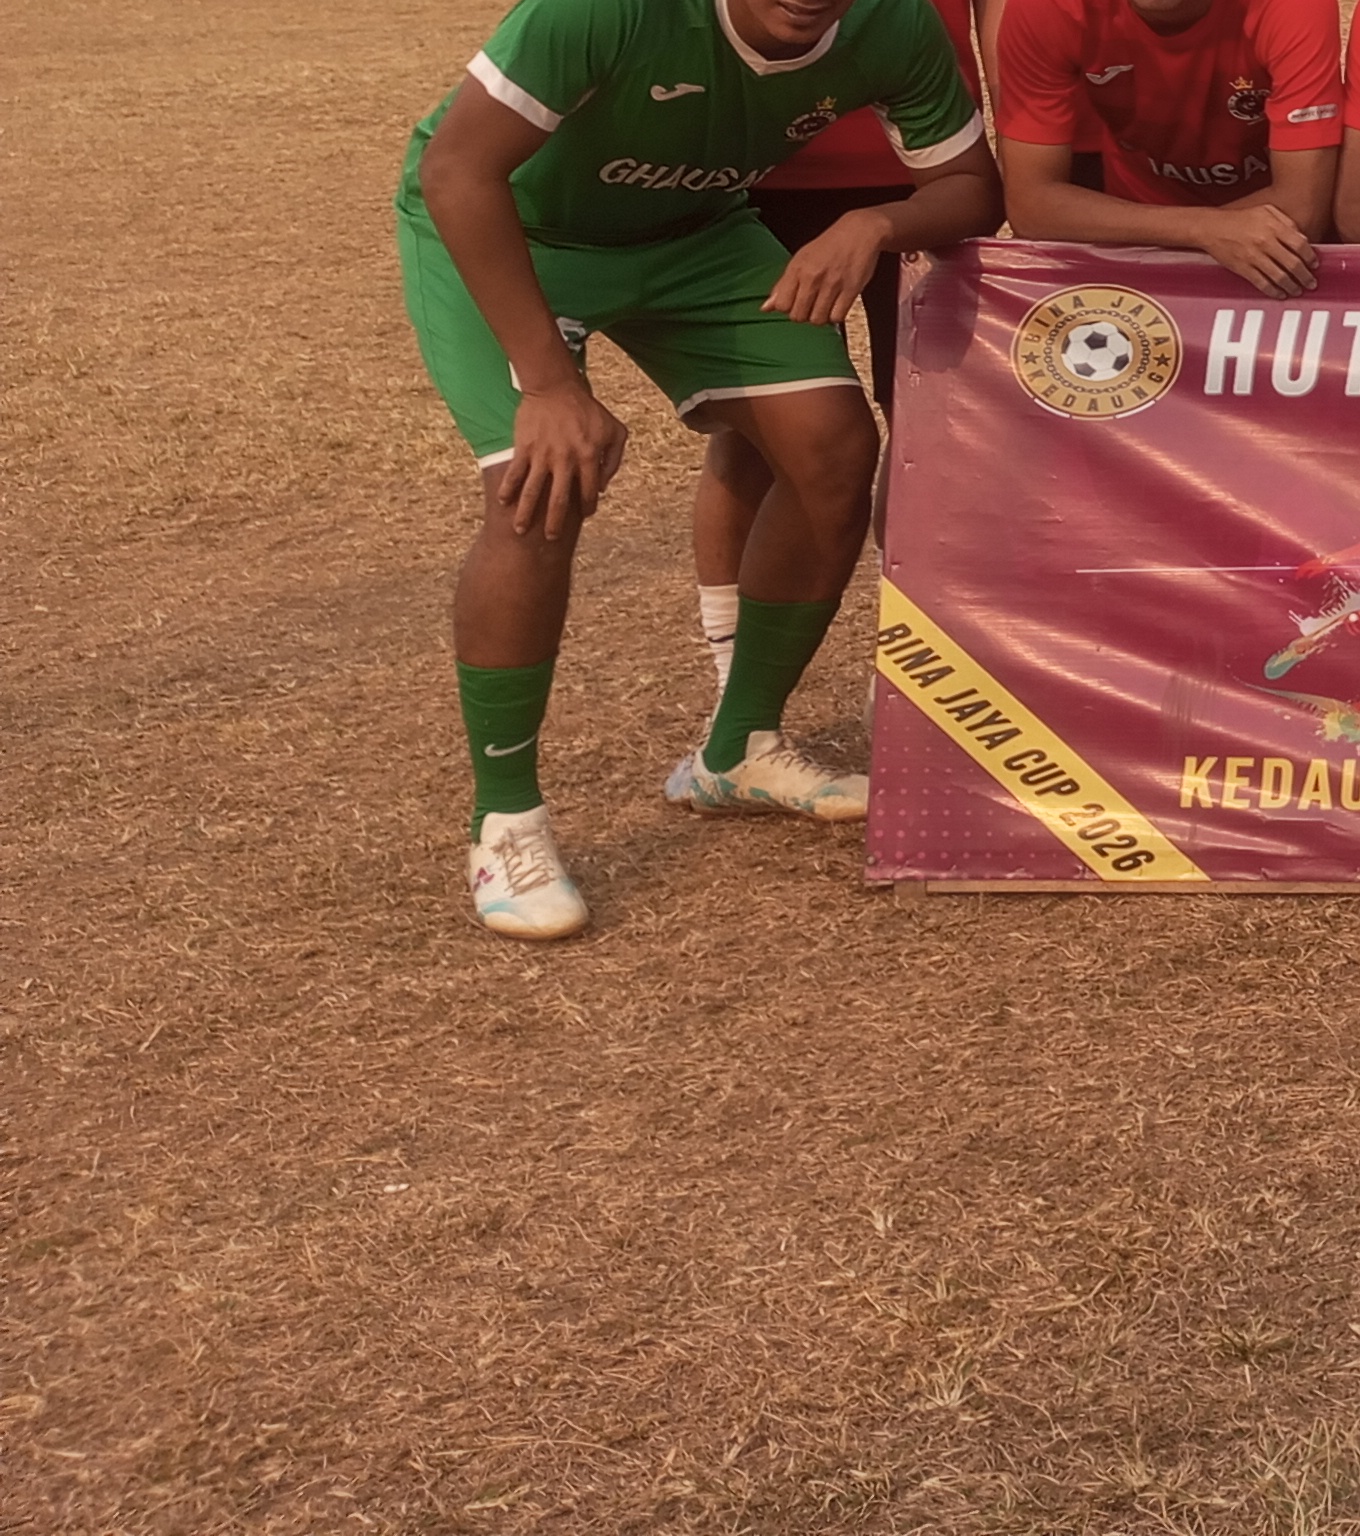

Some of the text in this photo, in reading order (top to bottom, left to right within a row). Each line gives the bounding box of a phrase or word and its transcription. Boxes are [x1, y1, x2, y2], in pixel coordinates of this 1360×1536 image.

[1024, 294, 1171, 350] BINA JAYA
[1027, 368, 1165, 413] KEDAUNG
[877, 622, 1156, 873] BINA JAYA CUP 2026
